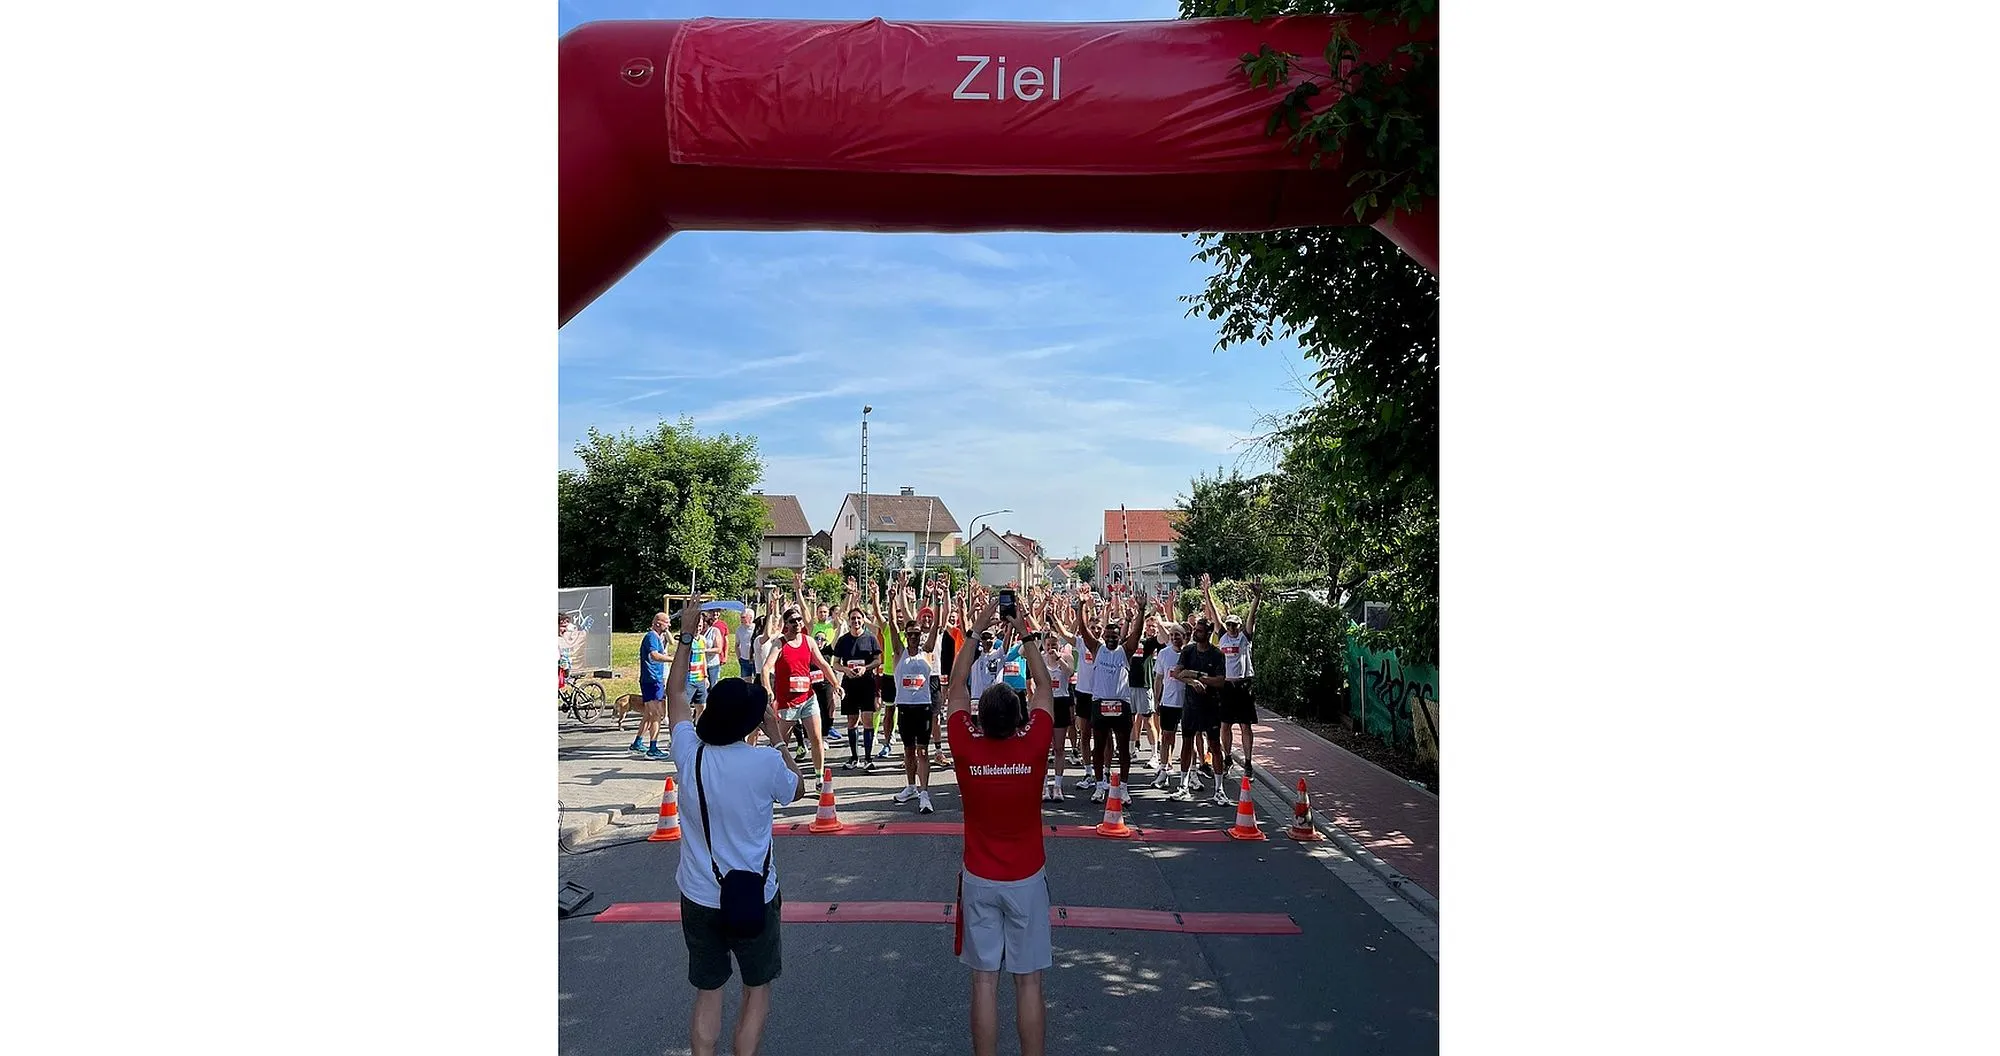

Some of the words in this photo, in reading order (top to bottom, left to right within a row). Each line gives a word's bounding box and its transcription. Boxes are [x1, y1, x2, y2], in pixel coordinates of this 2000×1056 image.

[953, 55, 1061, 101] Ziel
[969, 765, 982, 776] TSG
[982, 763, 1032, 776] Niederdorfelden
